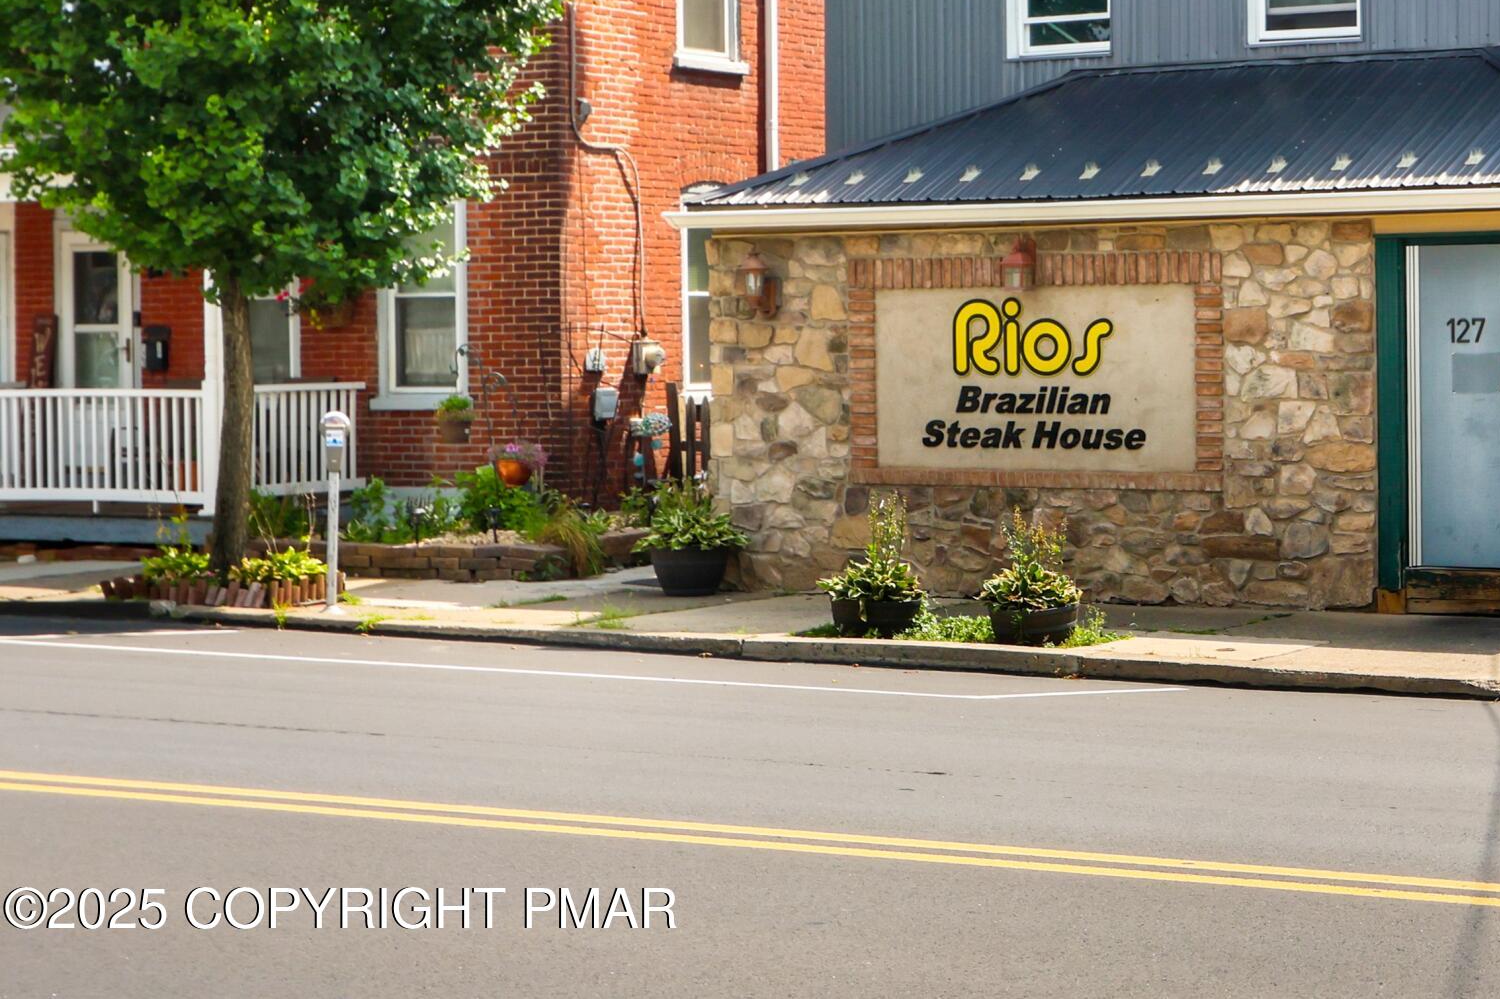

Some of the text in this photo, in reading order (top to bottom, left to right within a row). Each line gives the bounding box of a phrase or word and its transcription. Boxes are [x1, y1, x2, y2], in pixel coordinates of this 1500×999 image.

[953, 297, 1113, 376] Rios
[1447, 318, 1486, 344] 127
[956, 386, 1112, 414] Brazilian
[923, 420, 1147, 451] Steak House
